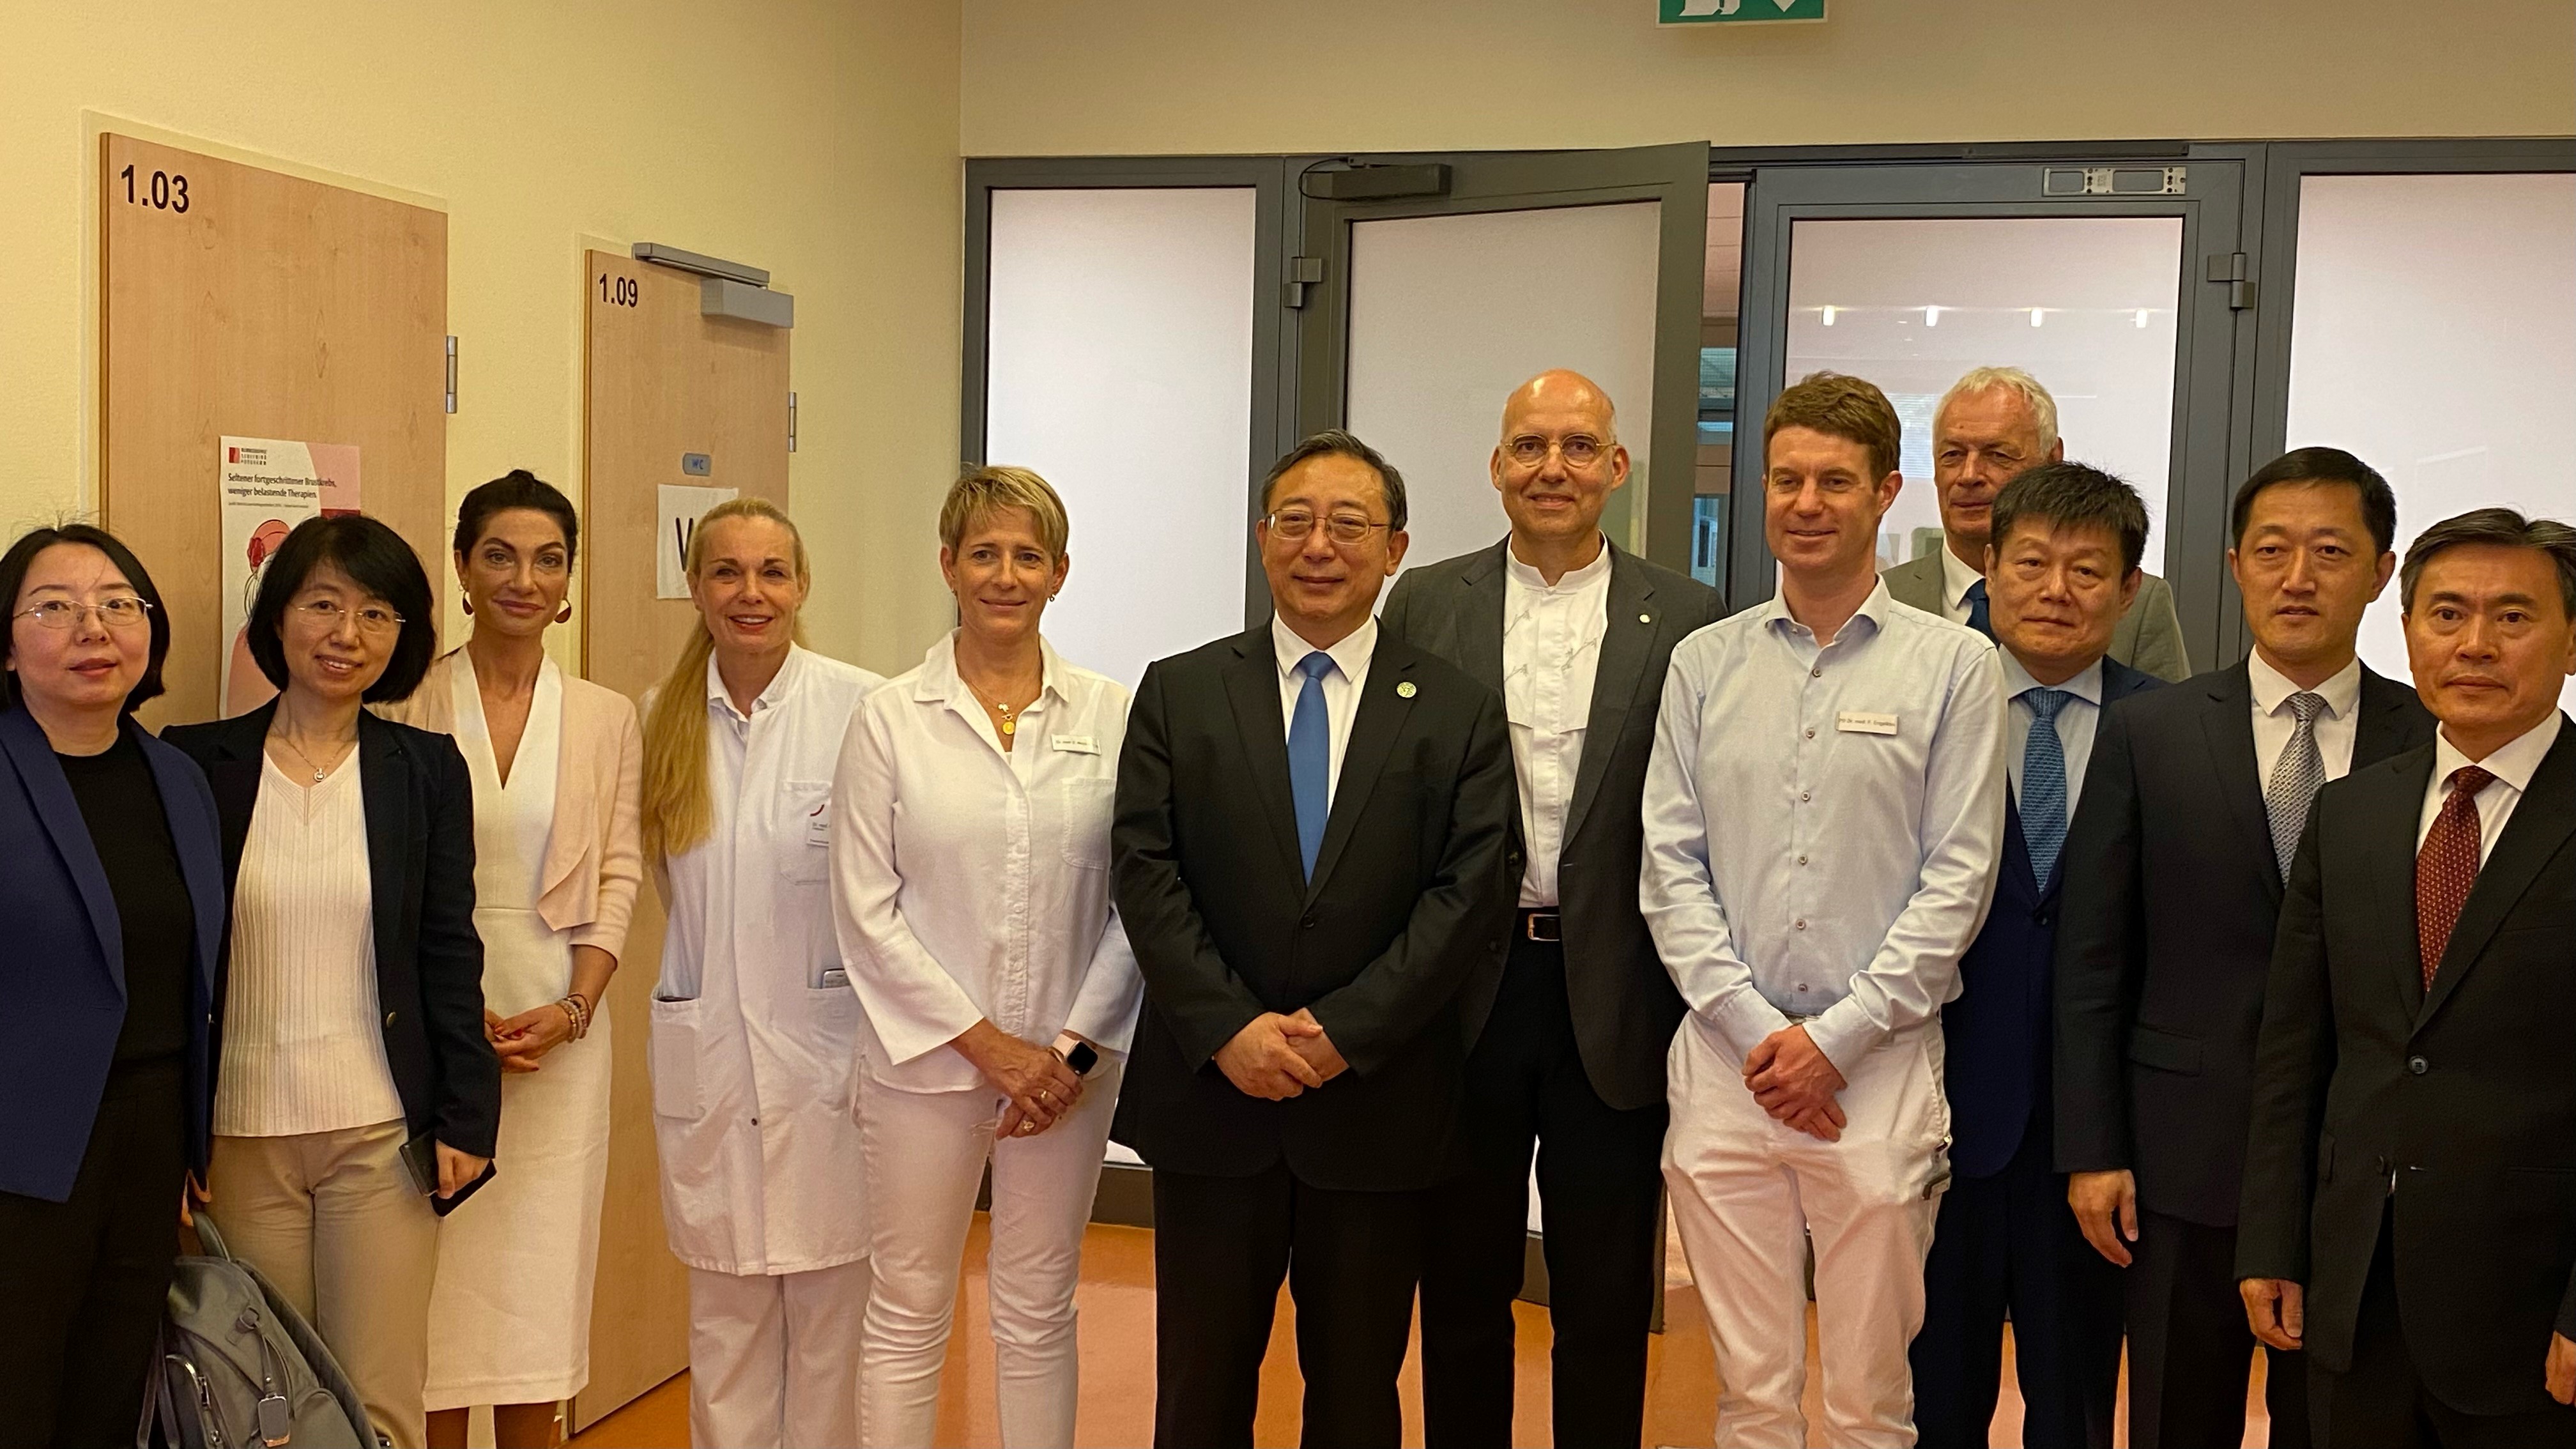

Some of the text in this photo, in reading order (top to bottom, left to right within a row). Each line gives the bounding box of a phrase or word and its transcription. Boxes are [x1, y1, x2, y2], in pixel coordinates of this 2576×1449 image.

[121, 164, 190, 214] 1.03
[599, 273, 638, 308] 1.09
[691, 458, 704, 470] WC
[228, 473, 254, 482] Seltener
[227, 487, 254, 497] weniger
[254, 487, 288, 497] belastende
